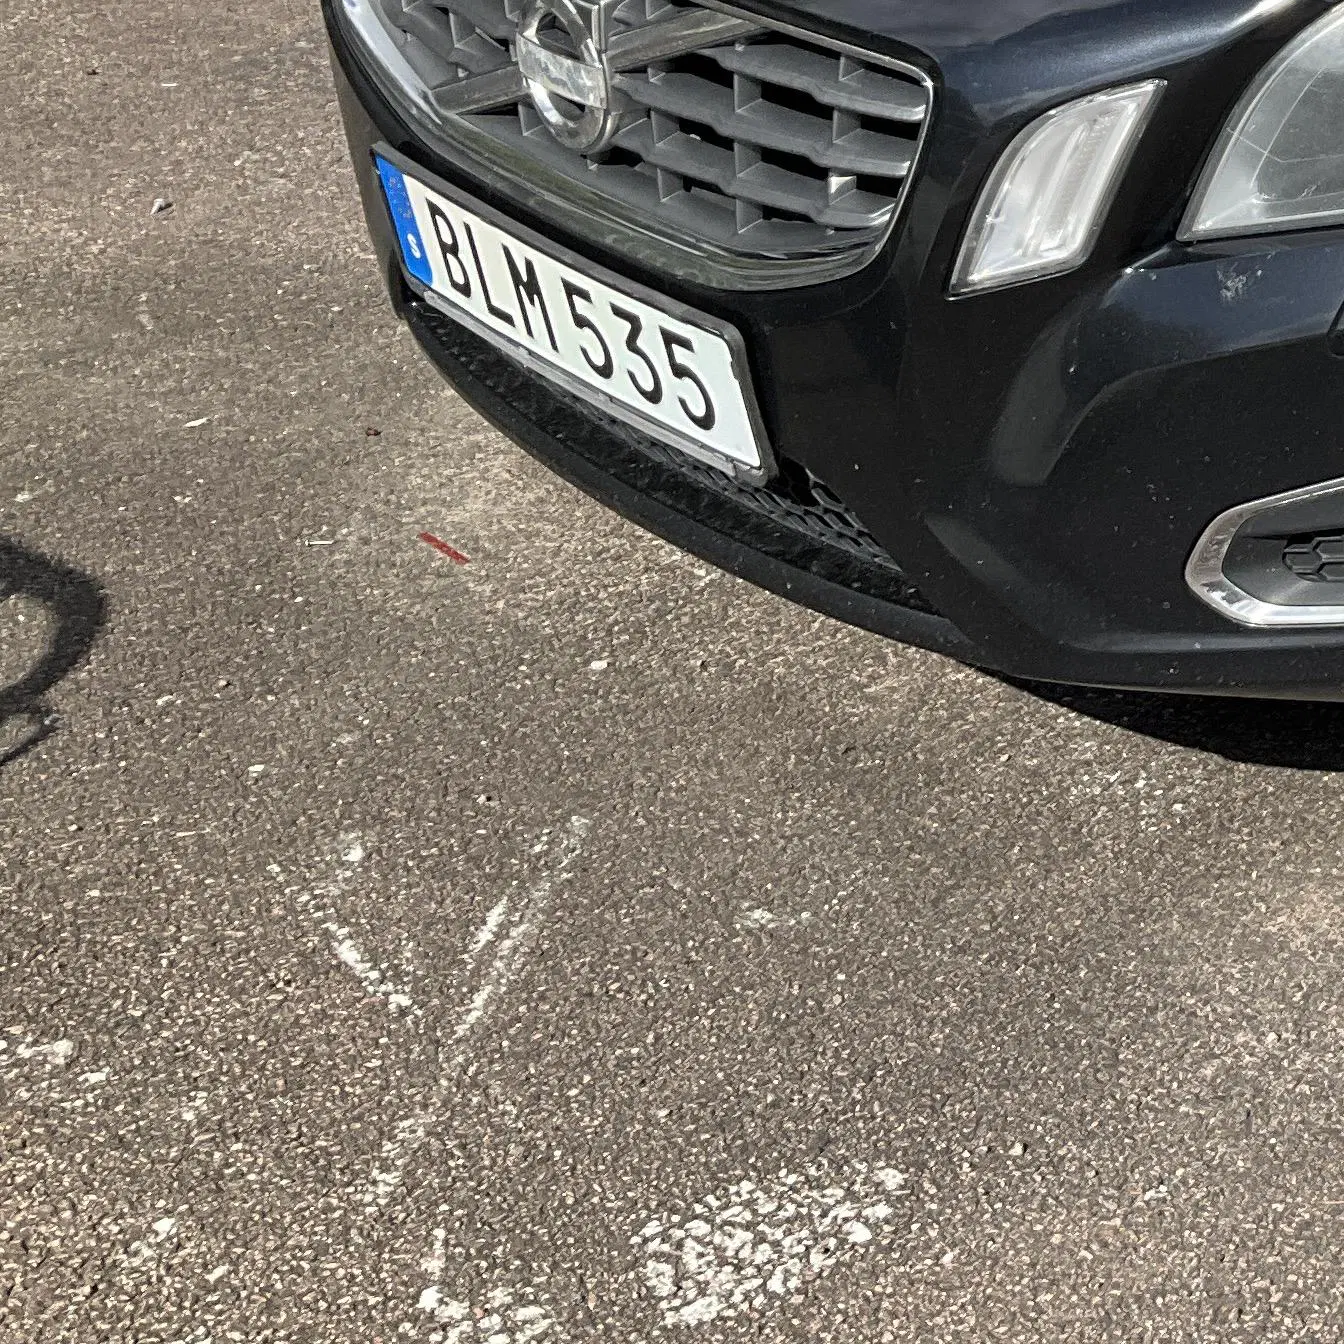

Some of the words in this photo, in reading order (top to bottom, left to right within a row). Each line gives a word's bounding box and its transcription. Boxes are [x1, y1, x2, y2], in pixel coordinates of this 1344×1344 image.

[406, 232, 422, 259] S
[425, 197, 560, 354] BLM
[560, 276, 717, 432] 535
